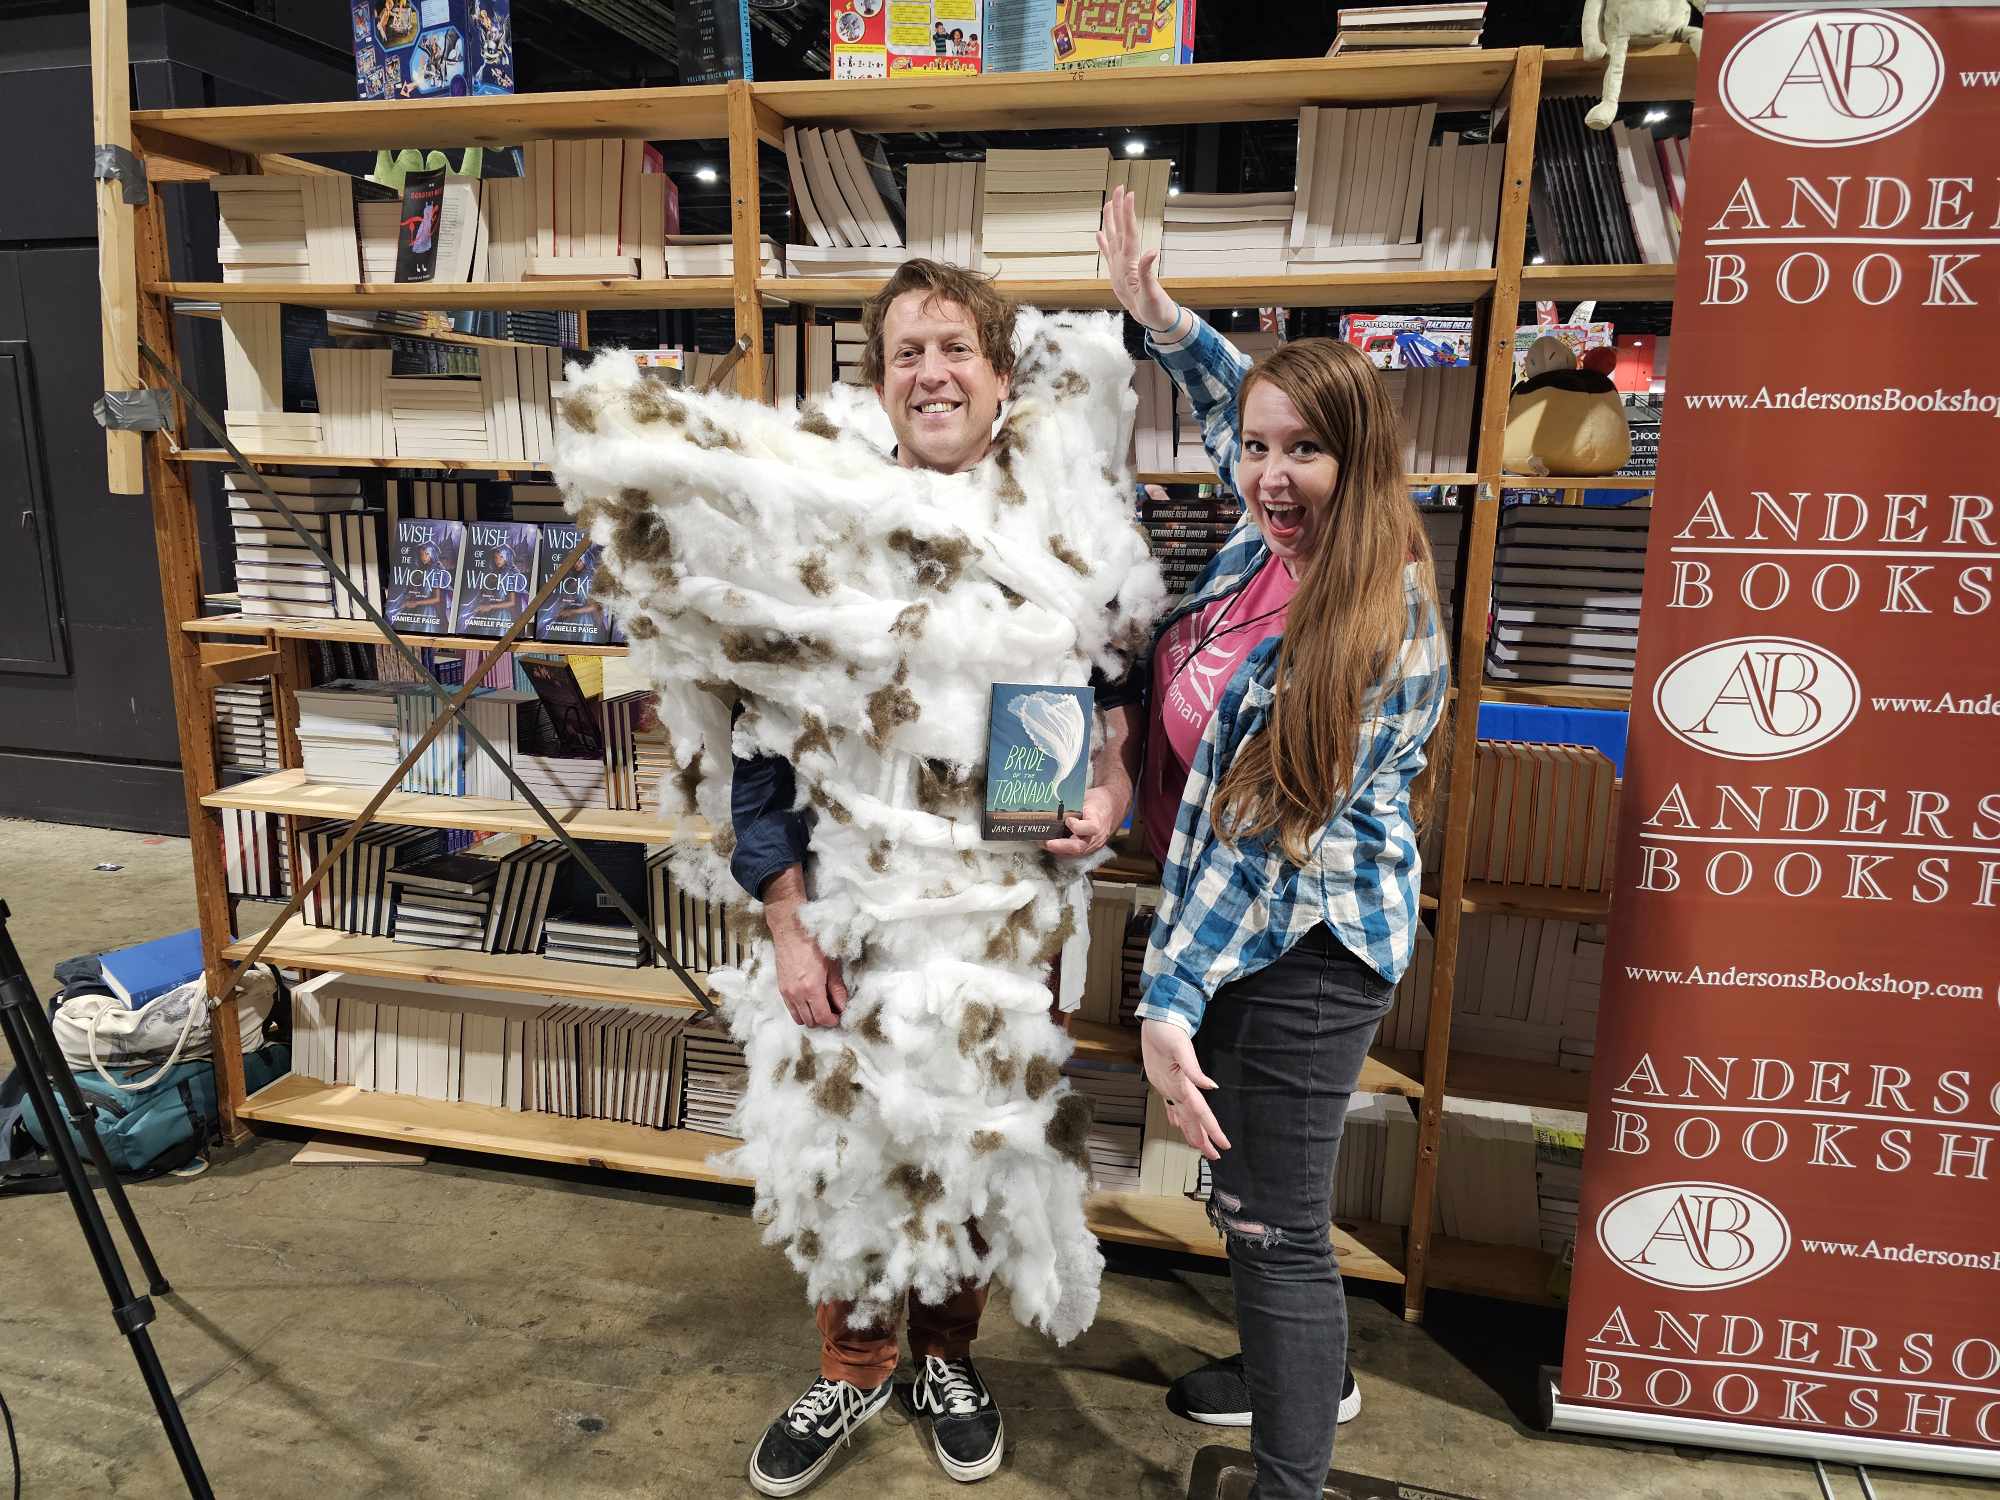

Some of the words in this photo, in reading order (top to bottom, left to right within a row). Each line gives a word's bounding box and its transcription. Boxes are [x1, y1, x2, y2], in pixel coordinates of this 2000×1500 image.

[1708, 176, 2000, 230] ANDE
[1700, 251, 1981, 306] BOOK
[1673, 490, 1997, 546] ANDER
[400, 523, 433, 543] WISH
[472, 526, 508, 546] WISH
[401, 546, 411, 554] OF
[402, 556, 412, 564] THE
[474, 550, 484, 558] OF
[475, 560, 486, 568] THE
[394, 566, 452, 592] WICKED
[467, 570, 527, 595] WICKED
[1666, 560, 1993, 615] BOOKS
[391, 615, 421, 624] DANIELLE
[422, 616, 441, 625] PAIGE
[464, 618, 494, 627] DANIELLE
[546, 625, 577, 633] DANIELLE
[578, 626, 598, 634] PAIGE
[1003, 745, 1046, 771] BRIDE
[992, 779, 1055, 808] TORNADO
[991, 825, 1015, 833] JAMES
[1017, 825, 1050, 833] KENNEDY
[1624, 965, 1984, 1000] www.AndersonsBookshop.com
[1614, 1052, 2000, 1117] ANDERS
[1608, 1110, 1995, 1180] BOOKSH
[1587, 1305, 2000, 1380] ANDERSO
